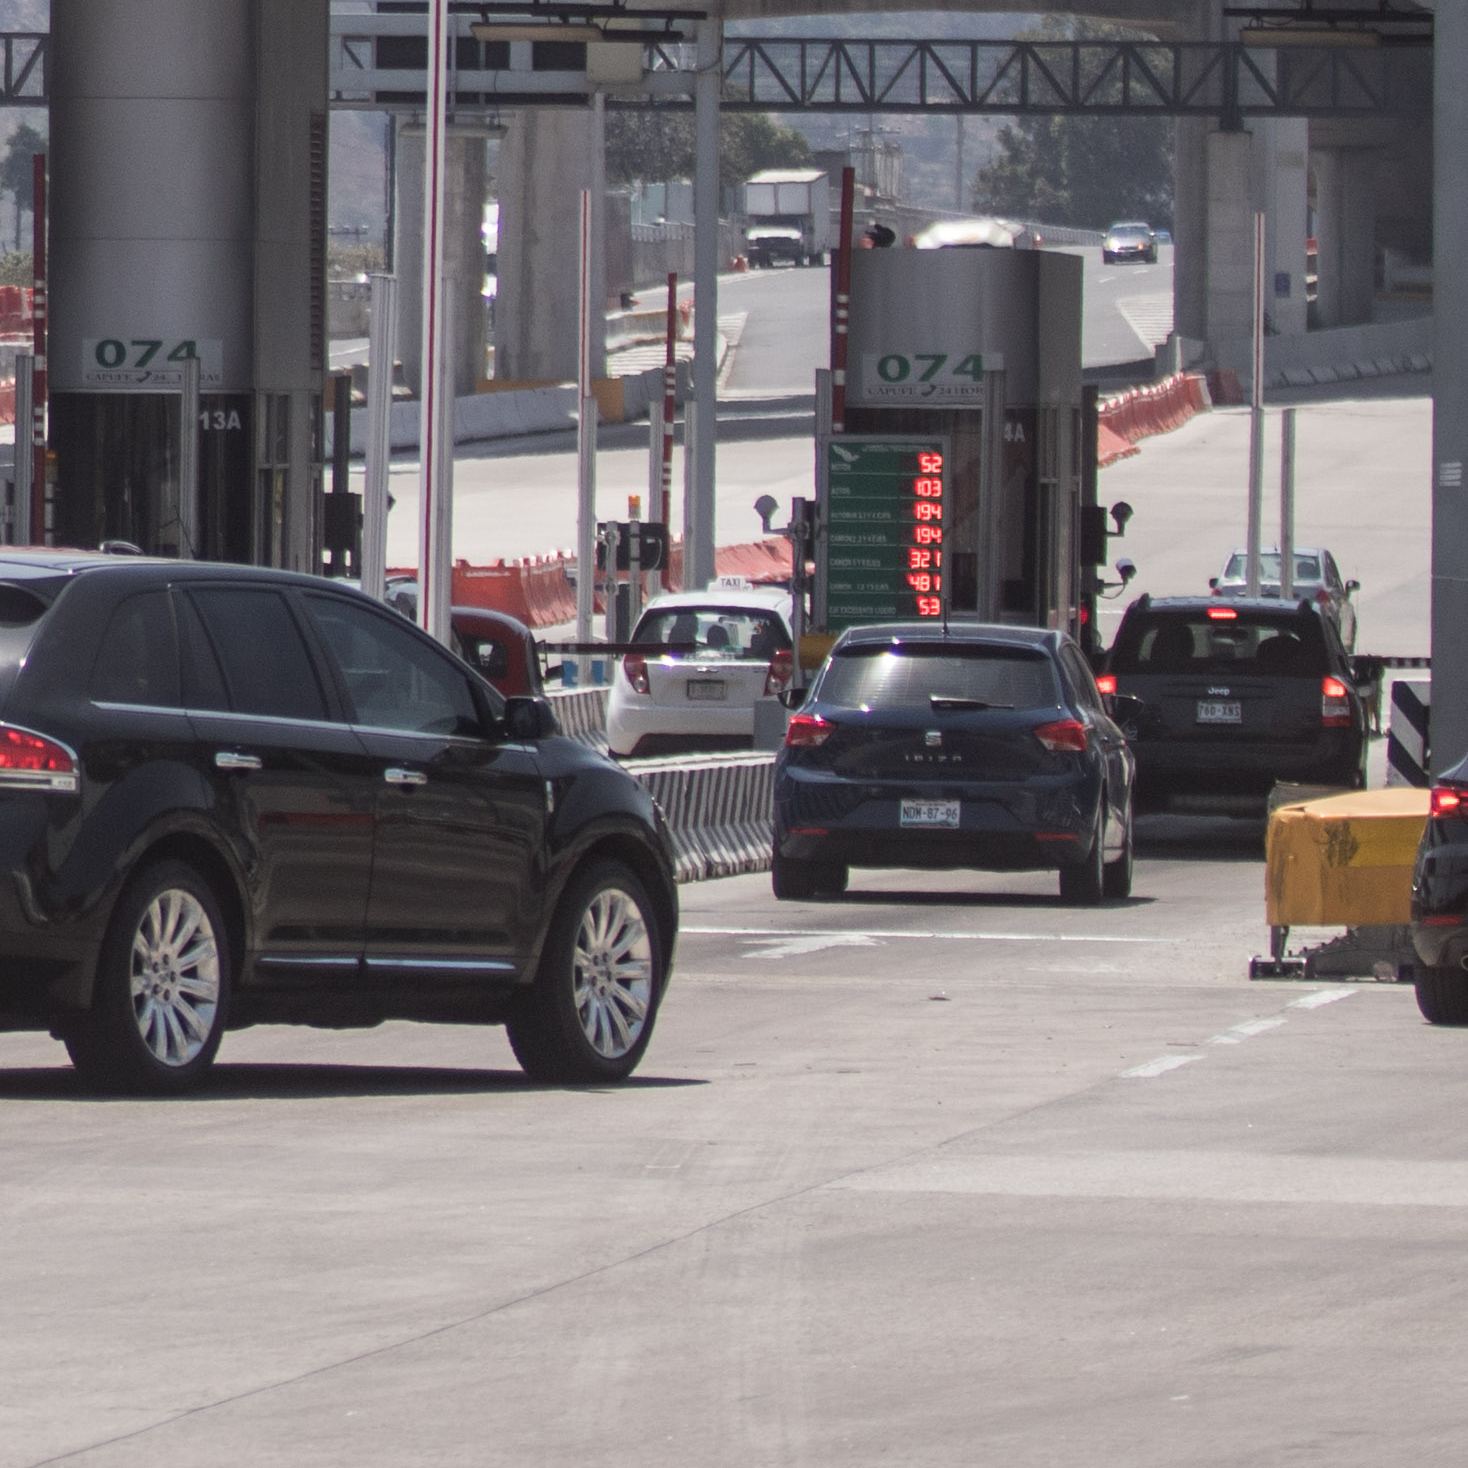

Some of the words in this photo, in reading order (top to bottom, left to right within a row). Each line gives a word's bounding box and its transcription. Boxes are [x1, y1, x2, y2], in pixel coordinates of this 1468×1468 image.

[95, 339, 197, 368] 074
[877, 354, 984, 383] 074
[199, 411, 241, 430] 13A
[919, 452, 943, 474] 52
[914, 477, 943, 498] 103
[914, 501, 943, 522] 194
[914, 525, 942, 544] 194
[909, 548, 941, 569] 321
[720, 578, 741, 588] TAXI
[907, 573, 941, 592] 481
[917, 596, 941, 616] 53
